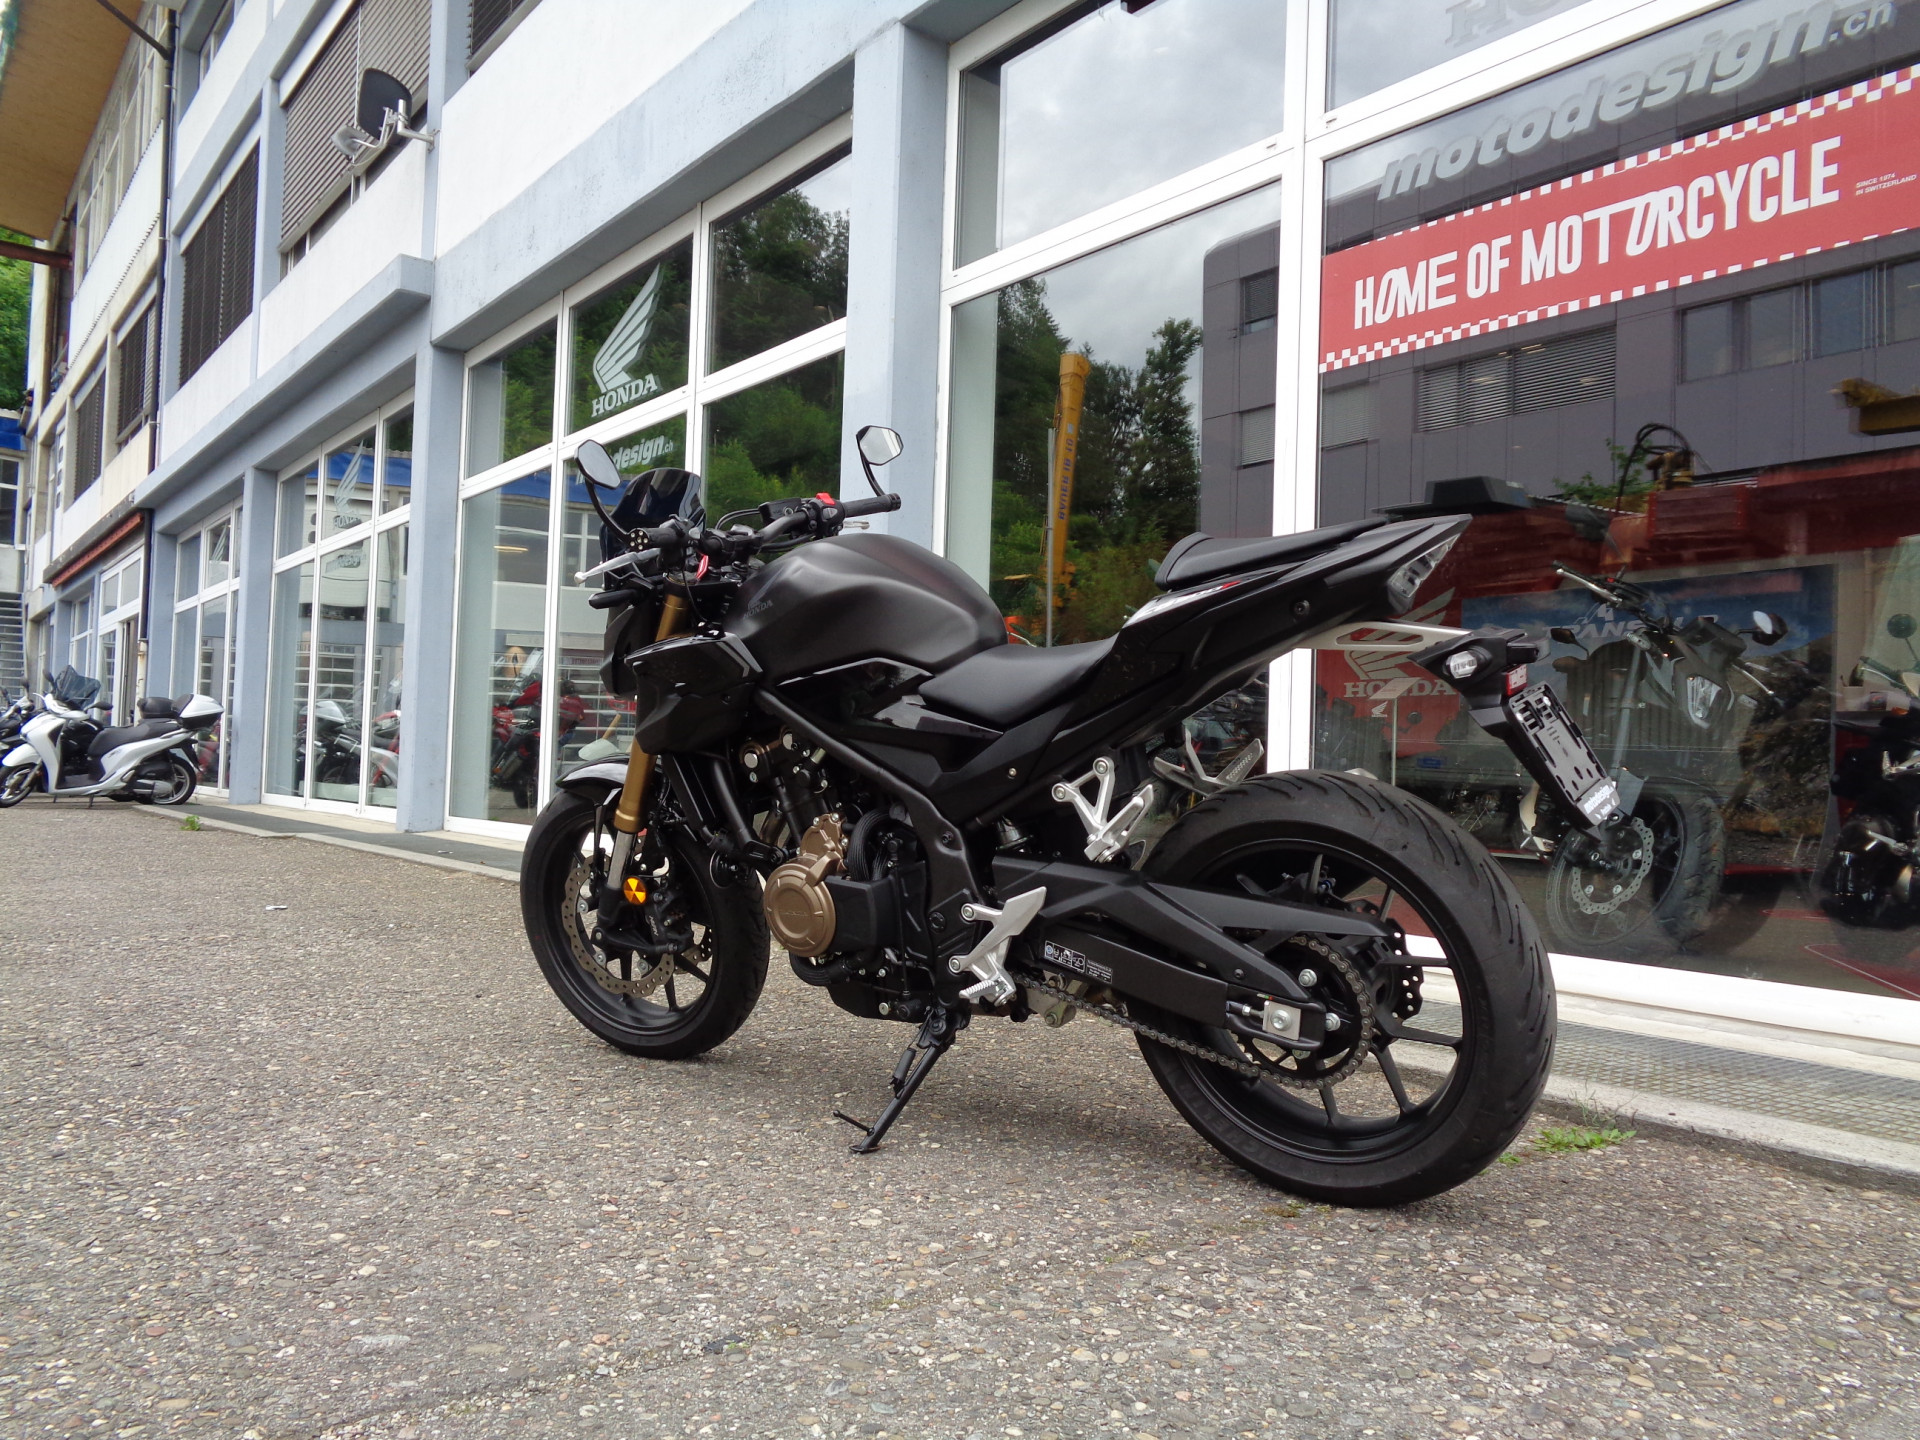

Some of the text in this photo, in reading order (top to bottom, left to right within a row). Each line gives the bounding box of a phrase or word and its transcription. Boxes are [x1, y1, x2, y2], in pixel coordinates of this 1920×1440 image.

[1378, 0, 1896, 200] motodesign.ch
[1855, 177, 1878, 189] SINCE
[1865, 174, 1917, 193] SWITZERLAND
[1354, 136, 1841, 330] HOME OF MOTORCYCLE
[591, 373, 658, 417] HONDA
[743, 600, 774, 621] HONDA
[1343, 679, 1457, 698] HODA
